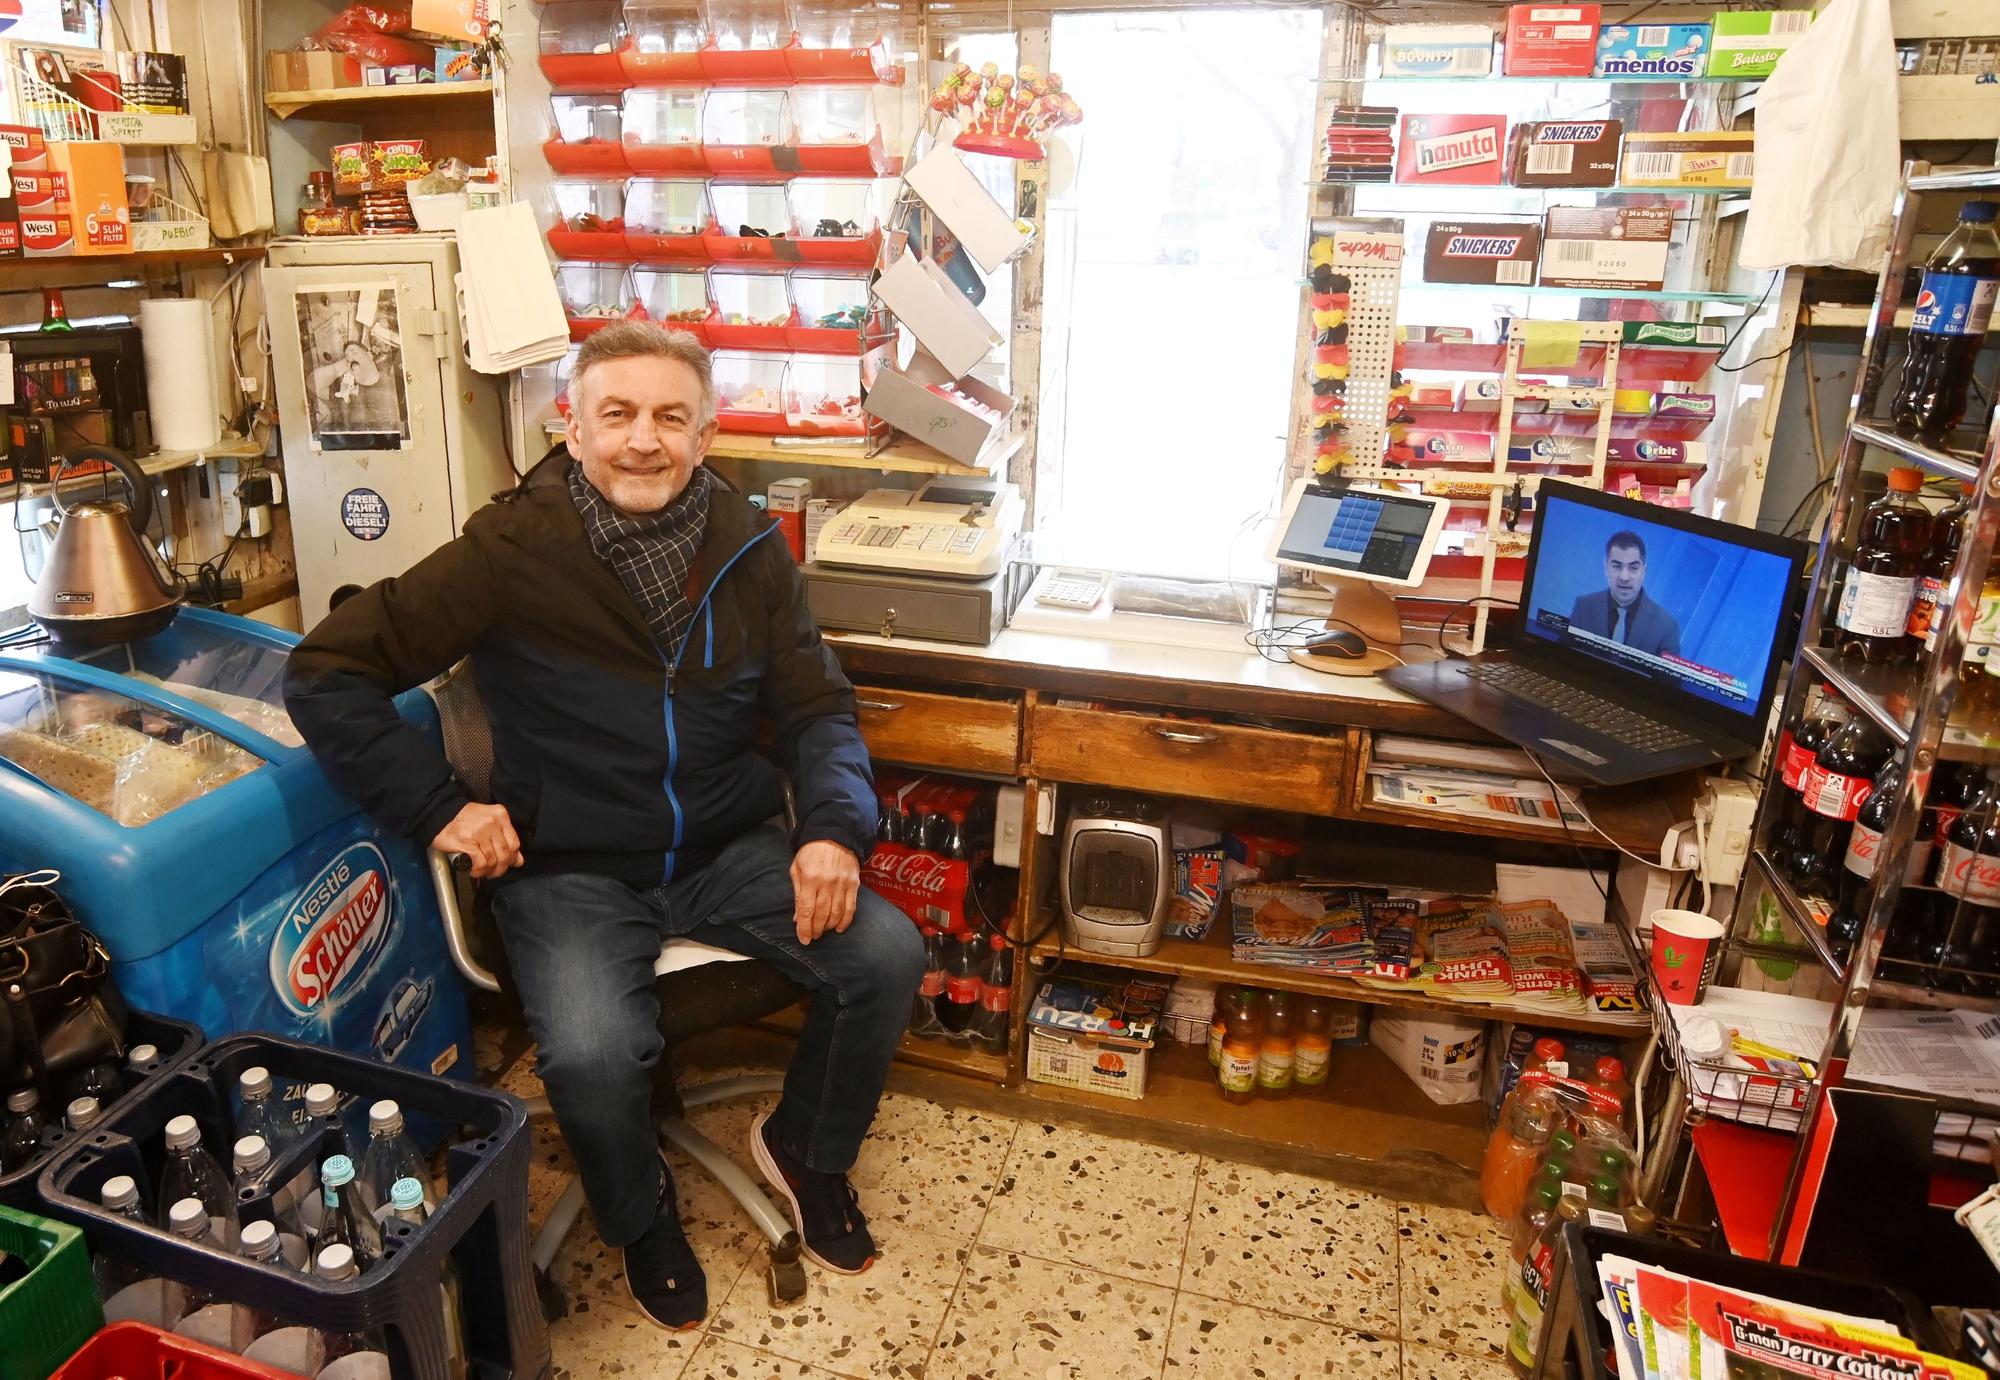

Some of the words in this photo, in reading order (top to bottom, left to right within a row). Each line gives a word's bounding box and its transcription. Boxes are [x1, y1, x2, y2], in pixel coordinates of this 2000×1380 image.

[1397, 51, 1453, 64] BOUNTY
[1604, 56, 1694, 73] mentos
[1731, 51, 1778, 68] Balisto
[1541, 123, 1602, 140] SNICKERS
[1420, 133, 1494, 165] hanuta
[26, 223, 53, 233] West
[86, 213, 99, 234] 6
[103, 225, 122, 234] SLIM
[103, 233, 124, 242] FILTER
[162, 226, 195, 240] PUEBLO
[1448, 239, 1516, 255] SNICKERS
[1638, 323, 1695, 339] Airwaves
[1663, 396, 1710, 409] Airwaves
[1645, 445, 1678, 457] Orbit
[348, 495, 379, 503] FREIE
[346, 503, 382, 513] FAHRT
[345, 517, 386, 527] DIESEL!
[865, 877, 903, 891] ORIGINAL
[906, 887, 932, 899] TASTE
[292, 859, 351, 934] Nestlé
[296, 876, 381, 1008] Schöller
[1445, 959, 1493, 972] UHR
[1440, 967, 1500, 980] FUNK
[1780, 1339, 1835, 1368] Jerry
[1836, 1353, 1917, 1380] Cotton
